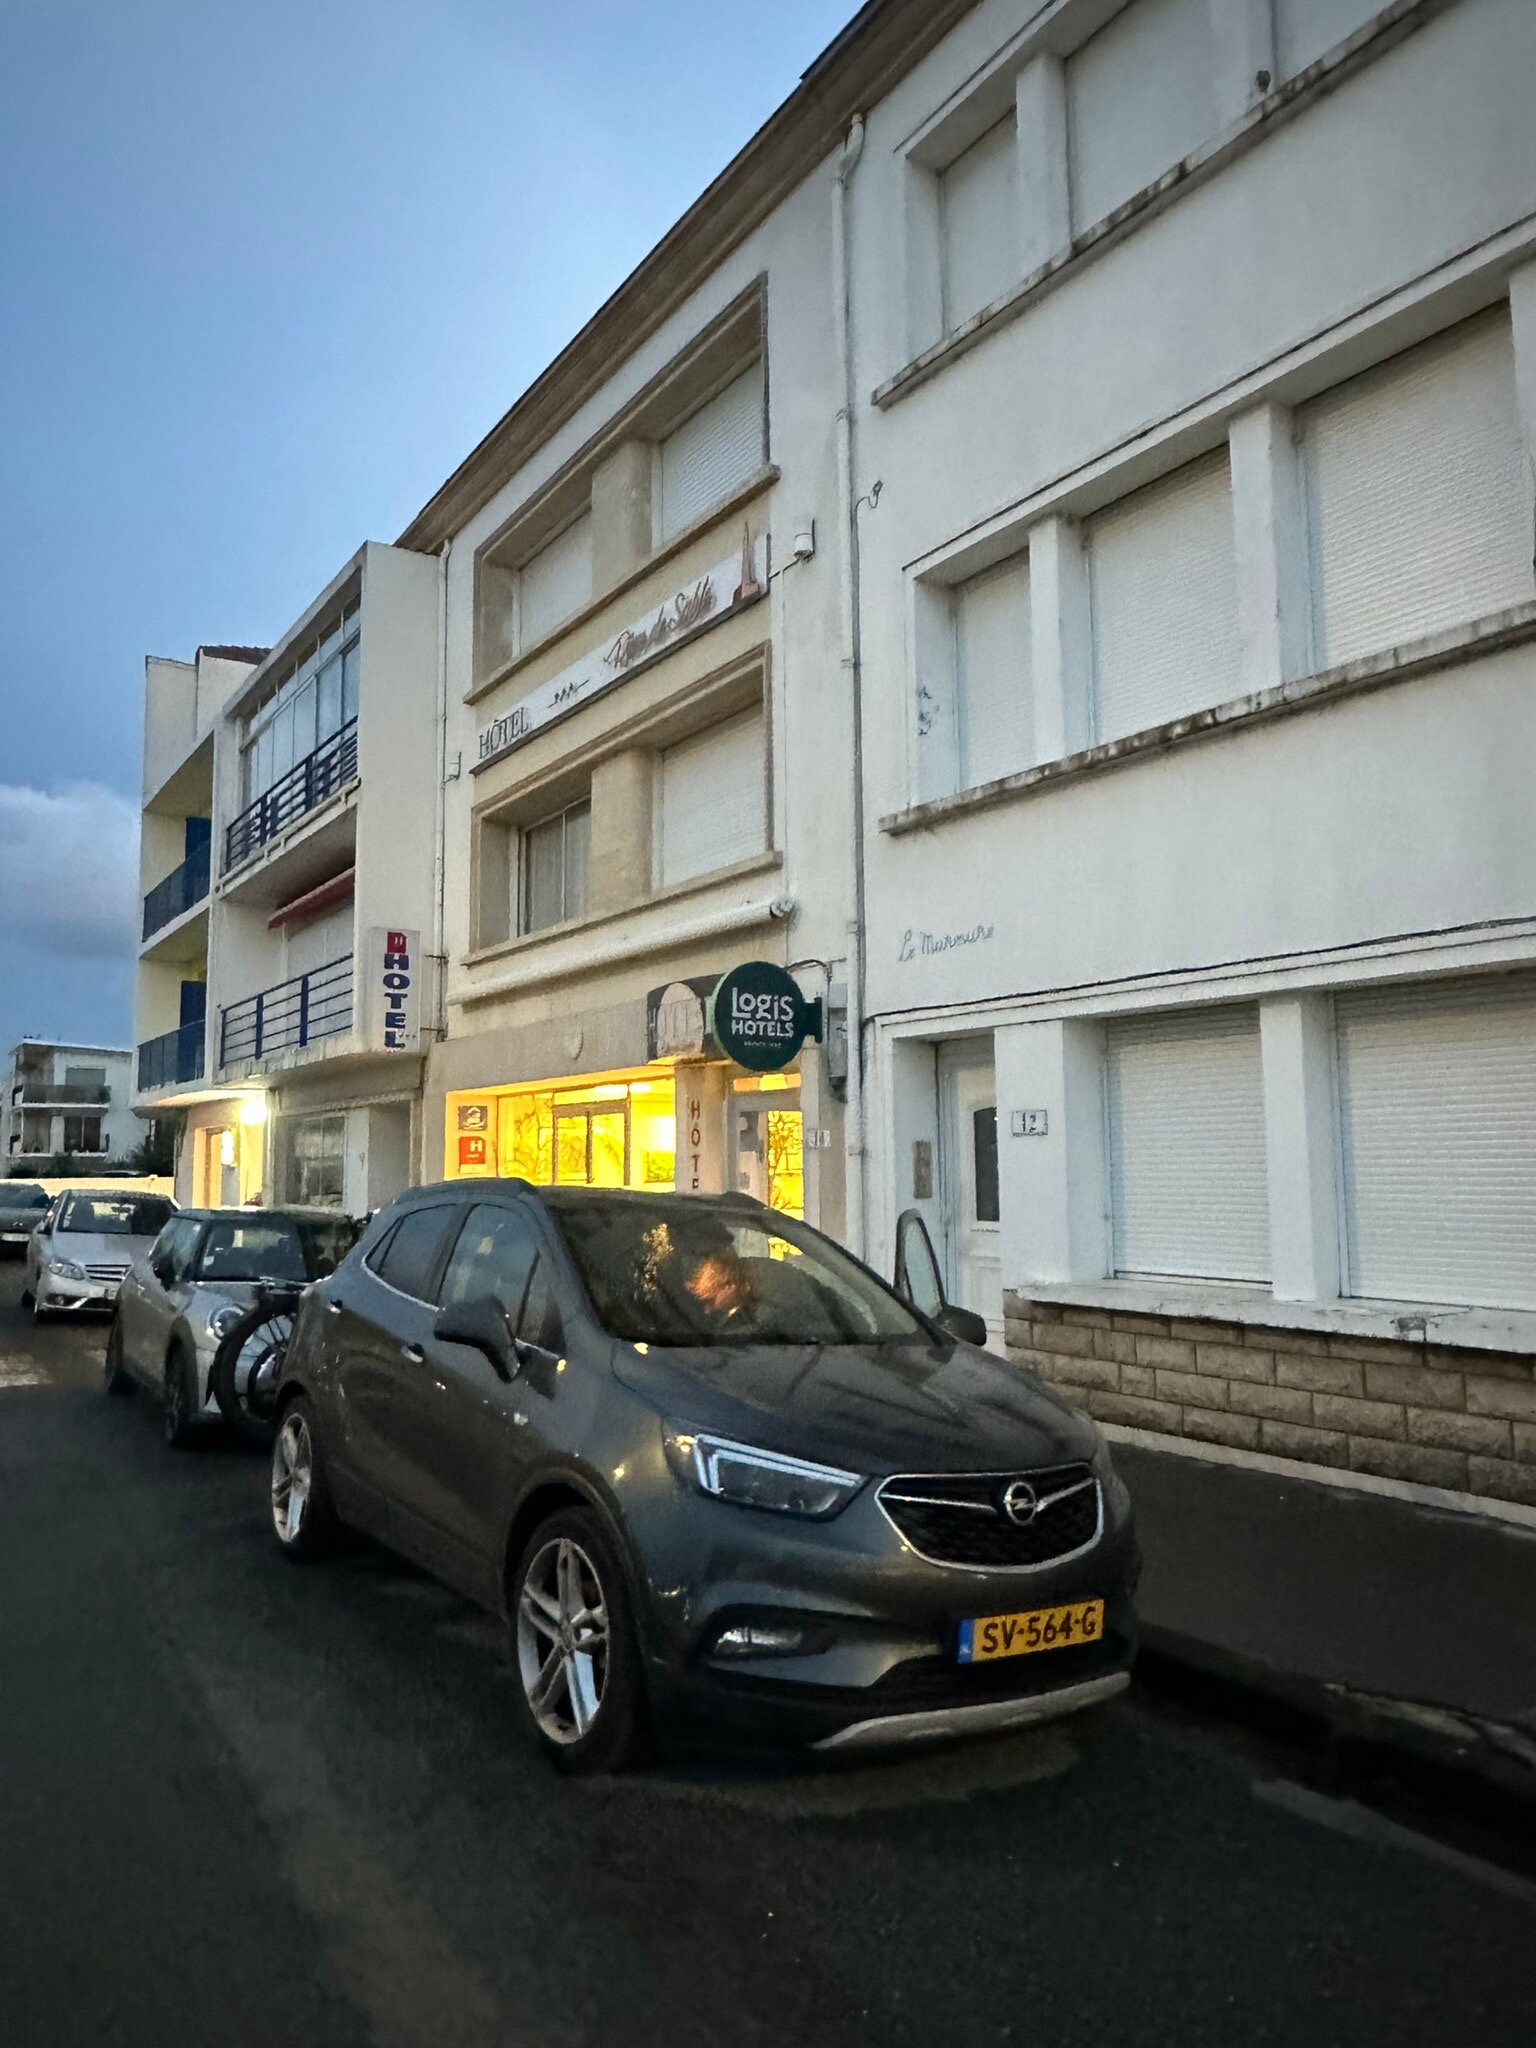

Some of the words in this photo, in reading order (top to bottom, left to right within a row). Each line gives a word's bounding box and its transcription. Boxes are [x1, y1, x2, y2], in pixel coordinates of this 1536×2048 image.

[731, 1019, 795, 1038] HOTELS
[1021, 1111, 1037, 1133] 12
[981, 1605, 1097, 1654] SV-564-G
